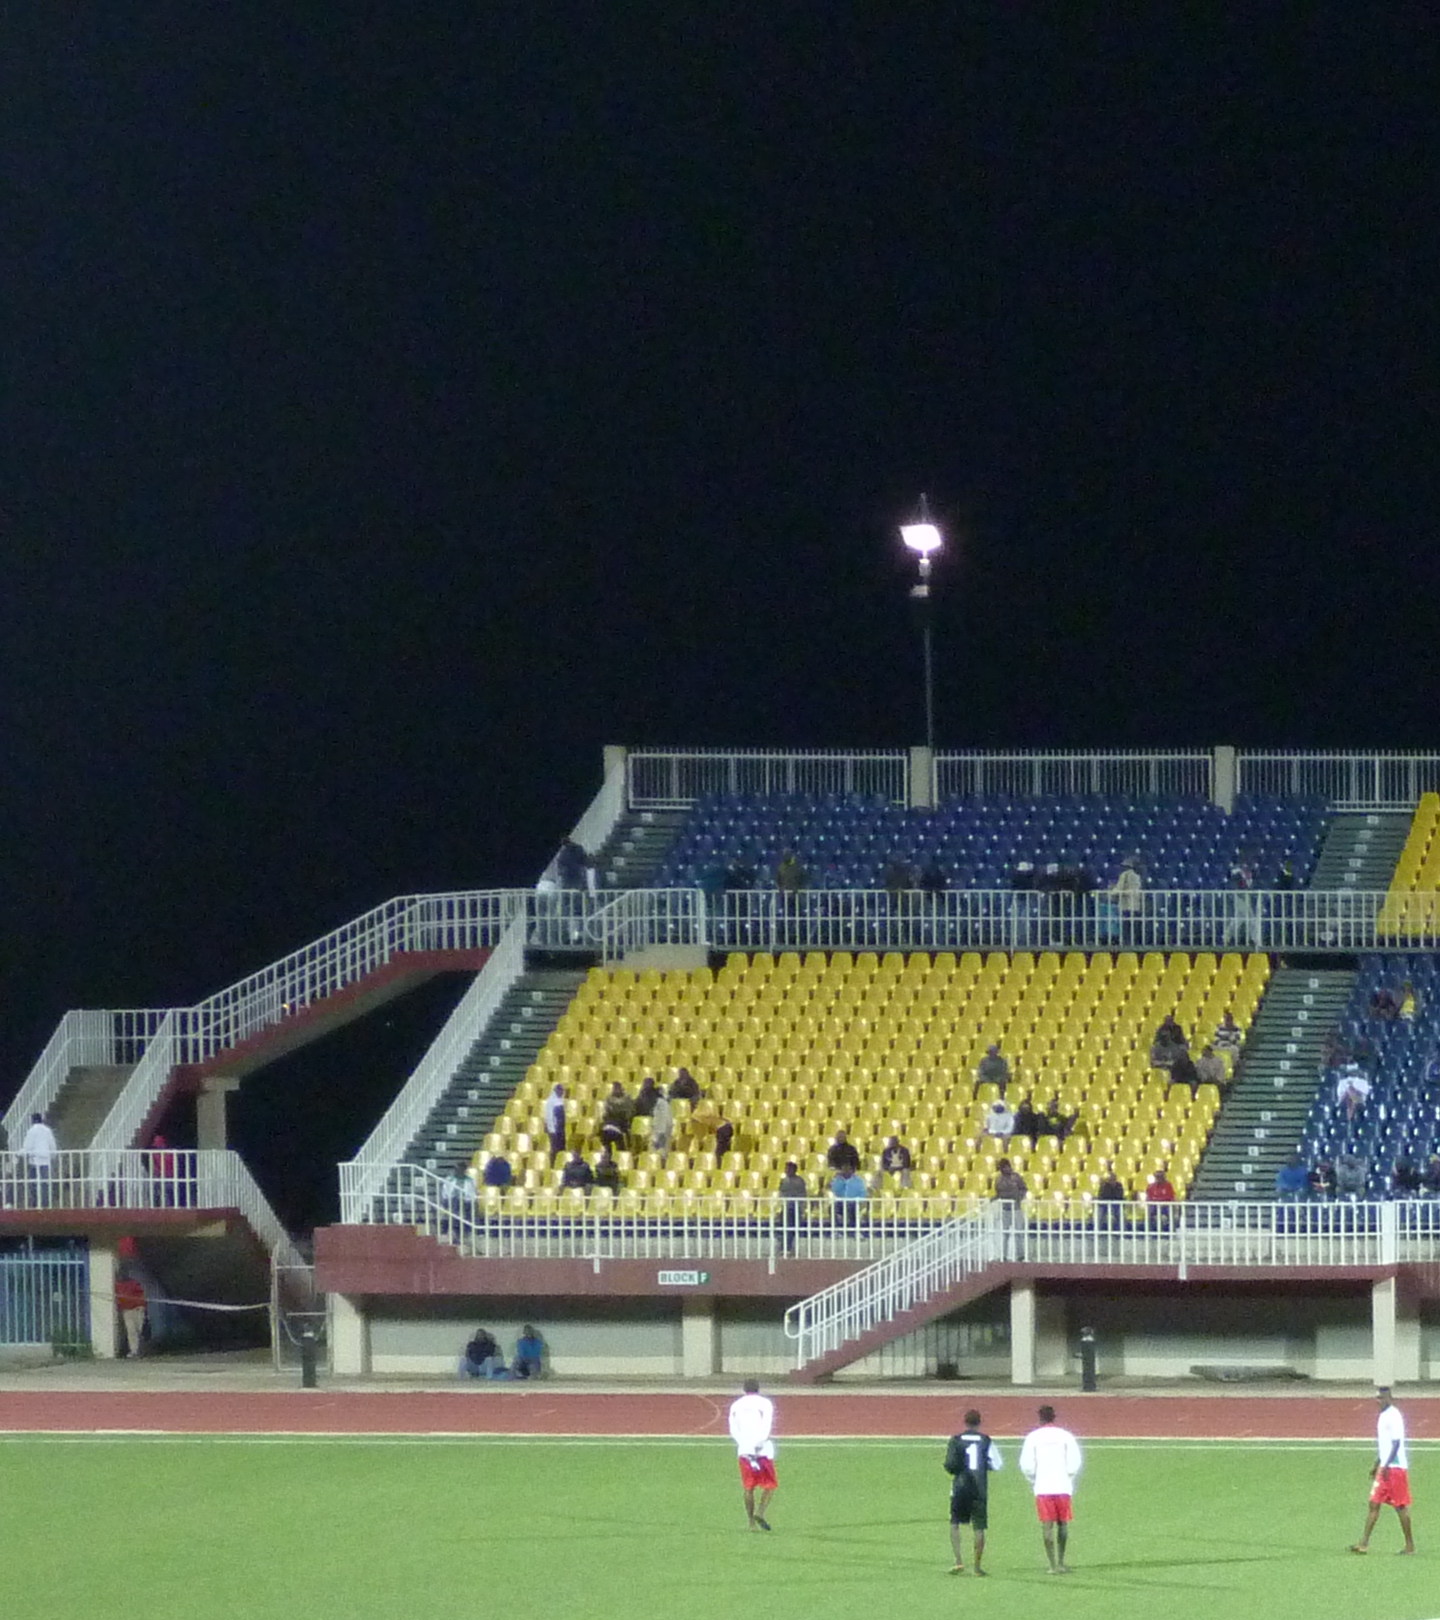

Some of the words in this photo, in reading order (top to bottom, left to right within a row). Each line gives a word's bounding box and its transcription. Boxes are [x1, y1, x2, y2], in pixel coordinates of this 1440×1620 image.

[660, 1272, 696, 1283] BLOCK
[700, 1272, 708, 1284] F
[965, 1442, 978, 1470] 1
